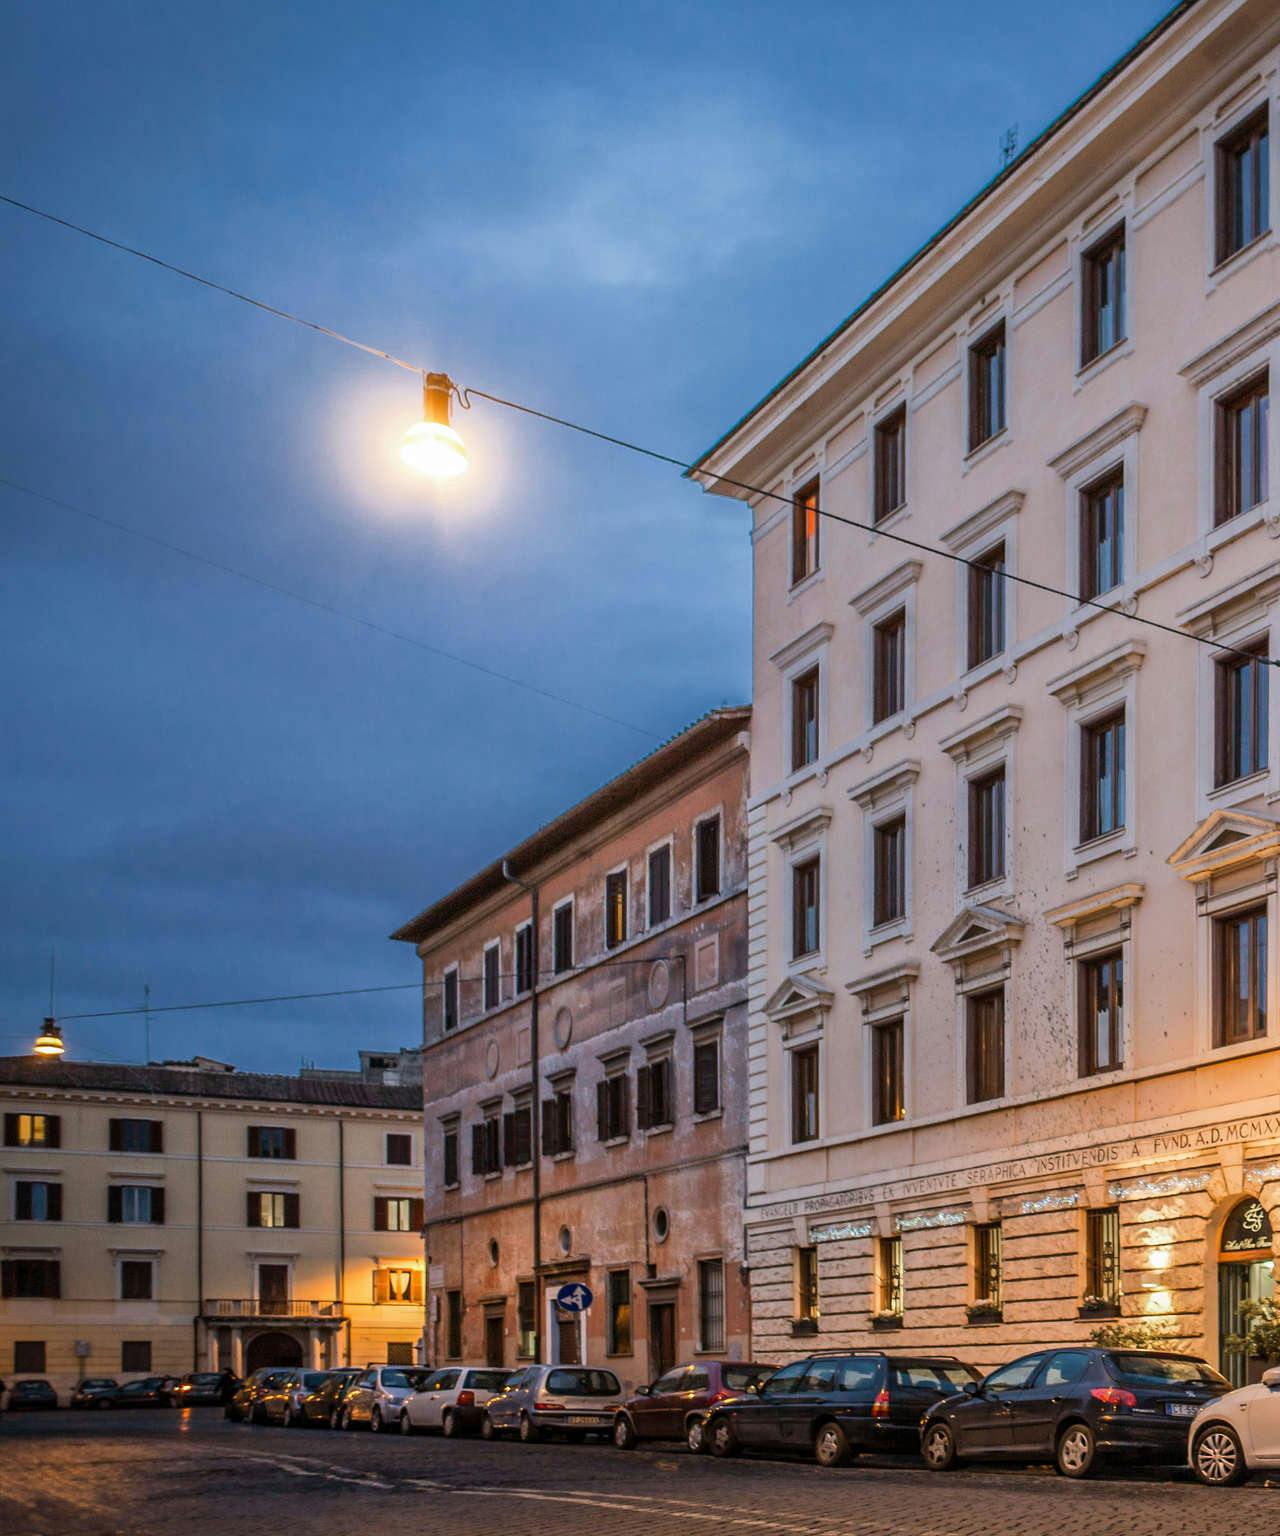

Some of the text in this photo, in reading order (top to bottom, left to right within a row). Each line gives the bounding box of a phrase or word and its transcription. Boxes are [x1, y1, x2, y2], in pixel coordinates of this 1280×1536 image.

[967, 1164, 1026, 1185] SERAPHICA
[1036, 1146, 1119, 1174] INSTITVENDIS
[1131, 1142, 1140, 1157] A
[1153, 1134, 1192, 1153] FVND.
